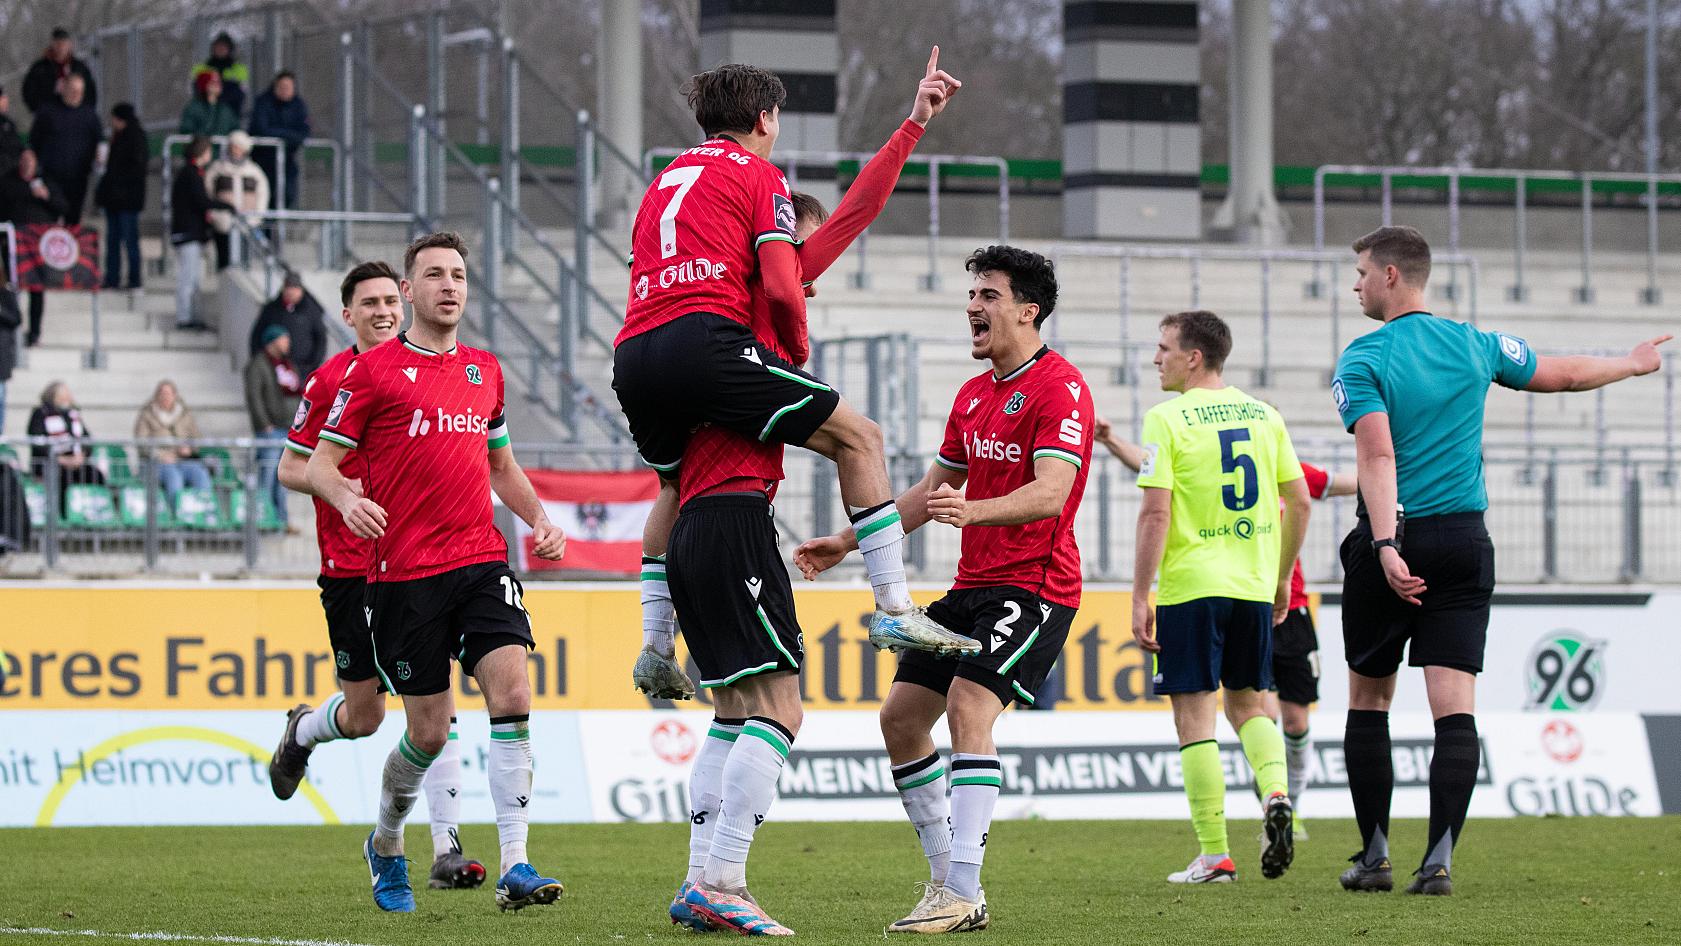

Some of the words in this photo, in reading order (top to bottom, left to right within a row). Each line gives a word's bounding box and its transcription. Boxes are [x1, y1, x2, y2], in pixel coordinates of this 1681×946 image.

[727, 151, 752, 165] 96
[657, 165, 705, 260] 7
[437, 407, 489, 435] heise
[972, 430, 1022, 463] heise
[1217, 427, 1259, 512] 5
[994, 600, 1022, 637] 2
[1535, 648, 1596, 704] 96
[1035, 752, 1136, 790] MEIN
